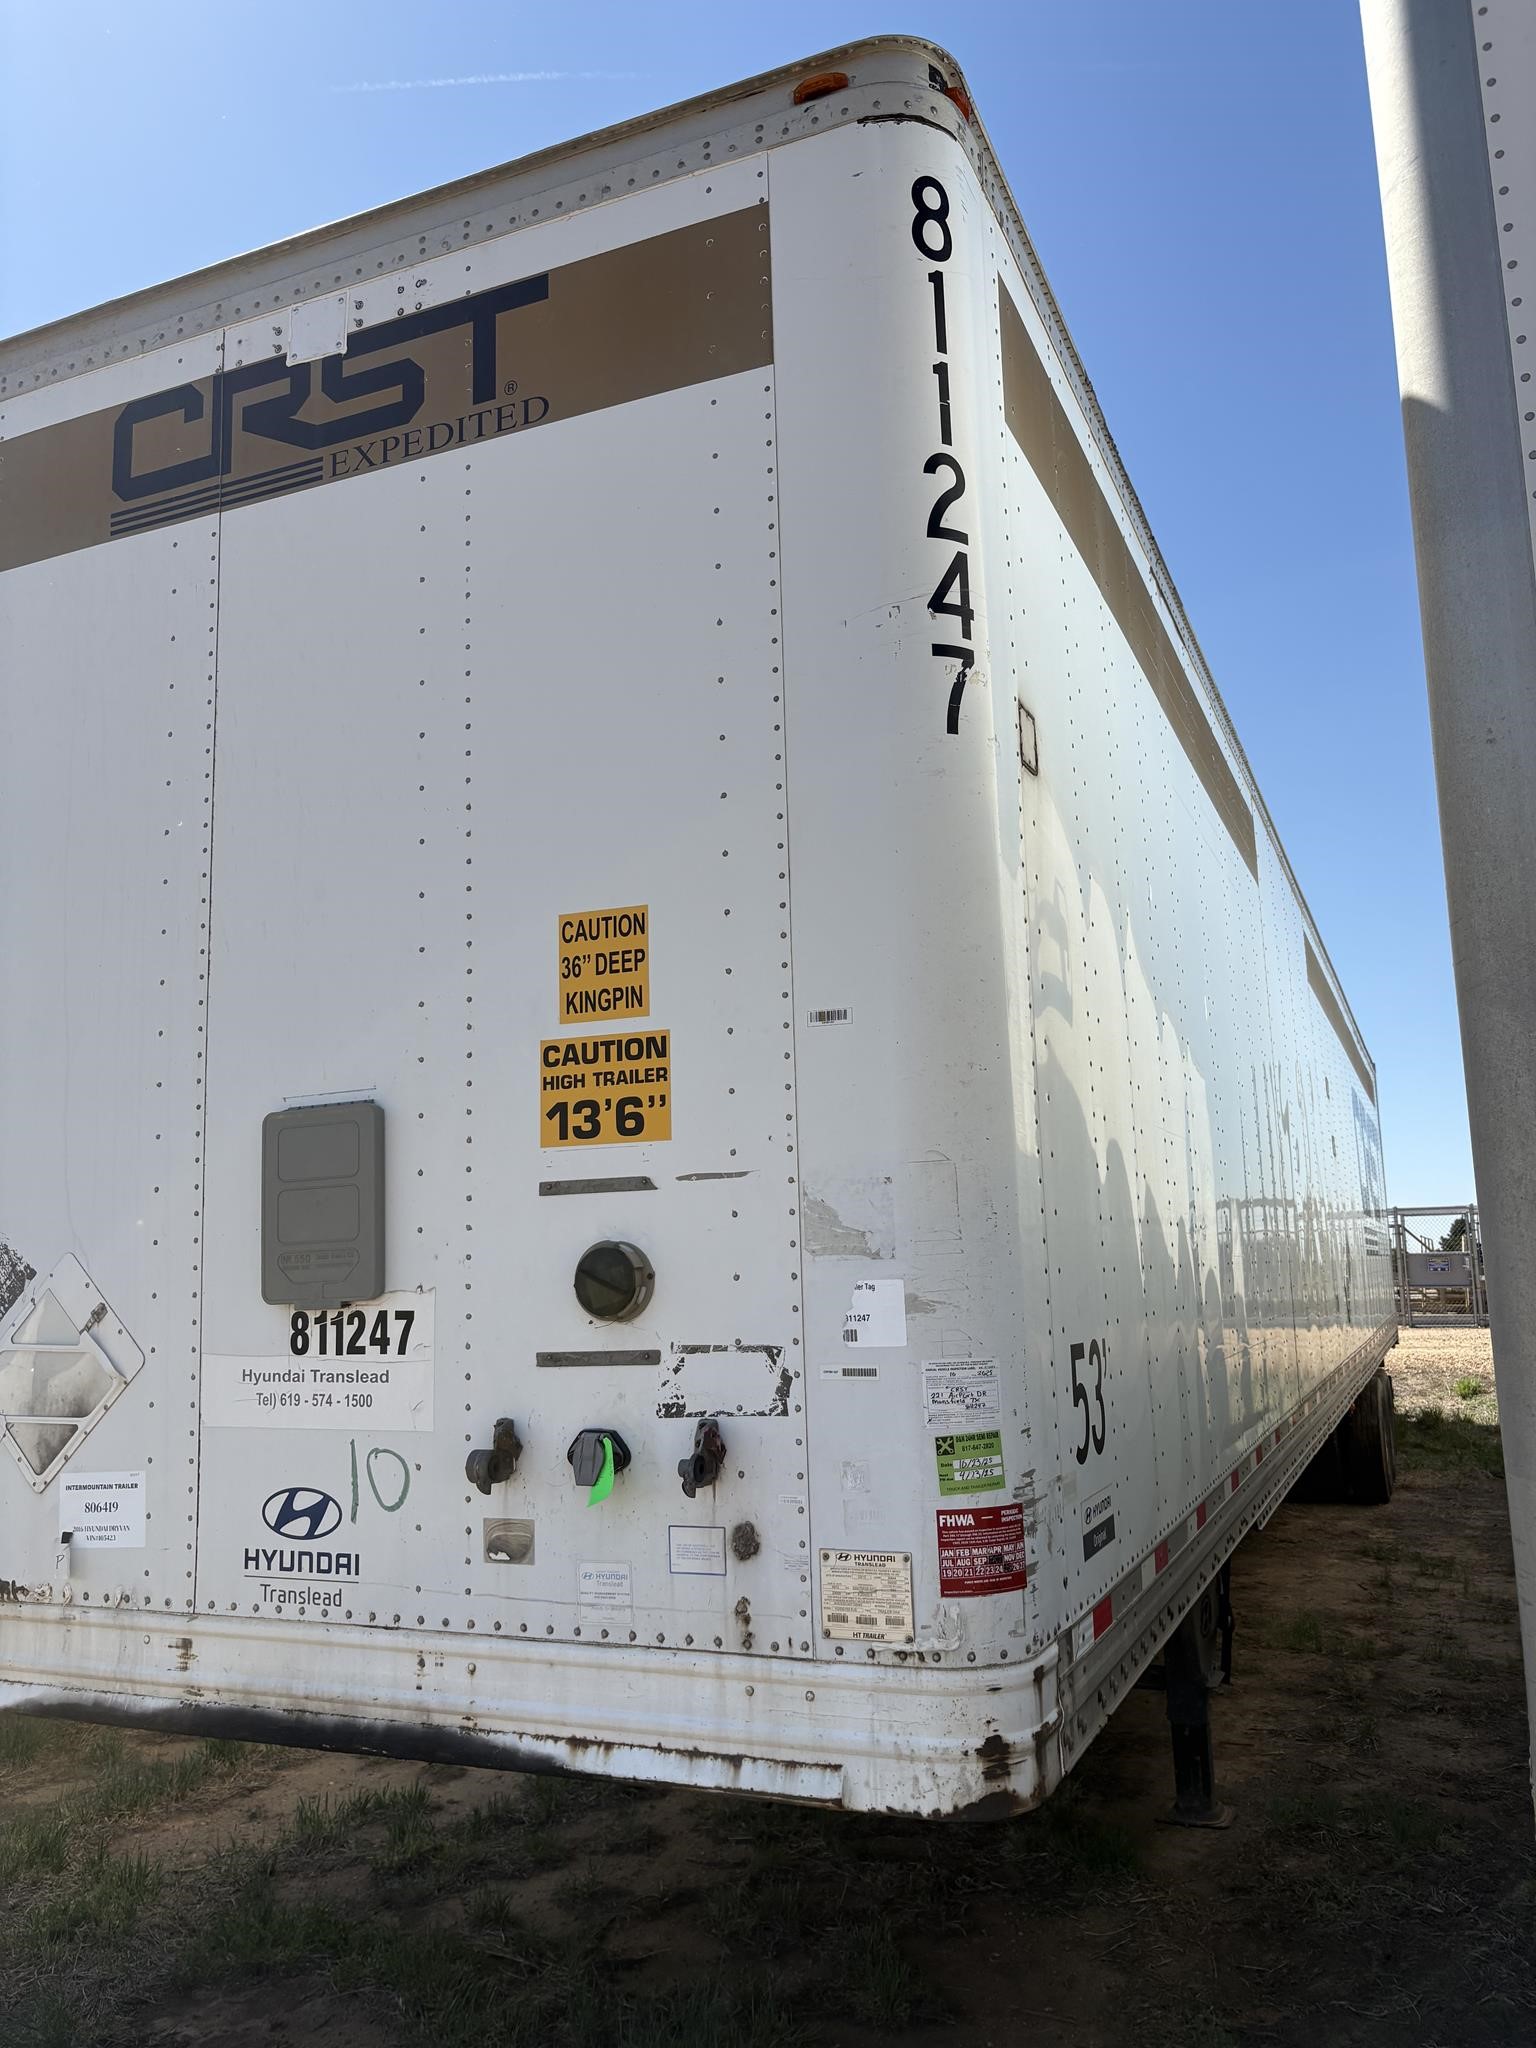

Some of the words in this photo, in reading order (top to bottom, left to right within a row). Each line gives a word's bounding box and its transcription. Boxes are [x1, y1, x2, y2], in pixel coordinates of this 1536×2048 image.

[112, 273, 549, 502] CRST
[329, 395, 551, 479] EXPEDITED
[911, 175, 975, 735] 811247
[561, 912, 646, 944] CAUTION
[595, 948, 646, 976] DEEP
[566, 985, 643, 1015] KINGPIN
[543, 1035, 667, 1068] CAUTION
[543, 1073, 586, 1091] HIGH
[592, 1067, 668, 1087] TRAILER
[865, 1283, 876, 1291] Tag
[290, 1309, 416, 1356] 811247
[242, 1368, 306, 1385] Hyundai
[310, 1369, 390, 1384] Translead
[256, 1392, 278, 1408] Tel)
[280, 1393, 301, 1407] 619
[312, 1393, 332, 1407] 574
[344, 1393, 373, 1408] 1500
[350, 1438, 410, 1524] 10
[84, 1501, 119, 1513] 806419
[939, 1514, 975, 1527] FHWA
[244, 1548, 360, 1576] HYUNDAI
[854, 1554, 896, 1563] HYUNDAI
[941, 1549, 954, 1557] JAN
[971, 1547, 987, 1555] MAR
[989, 1545, 1002, 1554] APR
[1003, 1543, 1015, 1552] MAY
[973, 1557, 987, 1565] SEP
[595, 1572, 628, 1580] HYUNDAI
[942, 1569, 952, 1577] 19
[964, 1568, 973, 1576] 21
[975, 1567, 985, 1575] 22
[986, 1567, 995, 1575] 23
[260, 1584, 342, 1608] Translead
[862, 1632, 886, 1640] TRAILER
